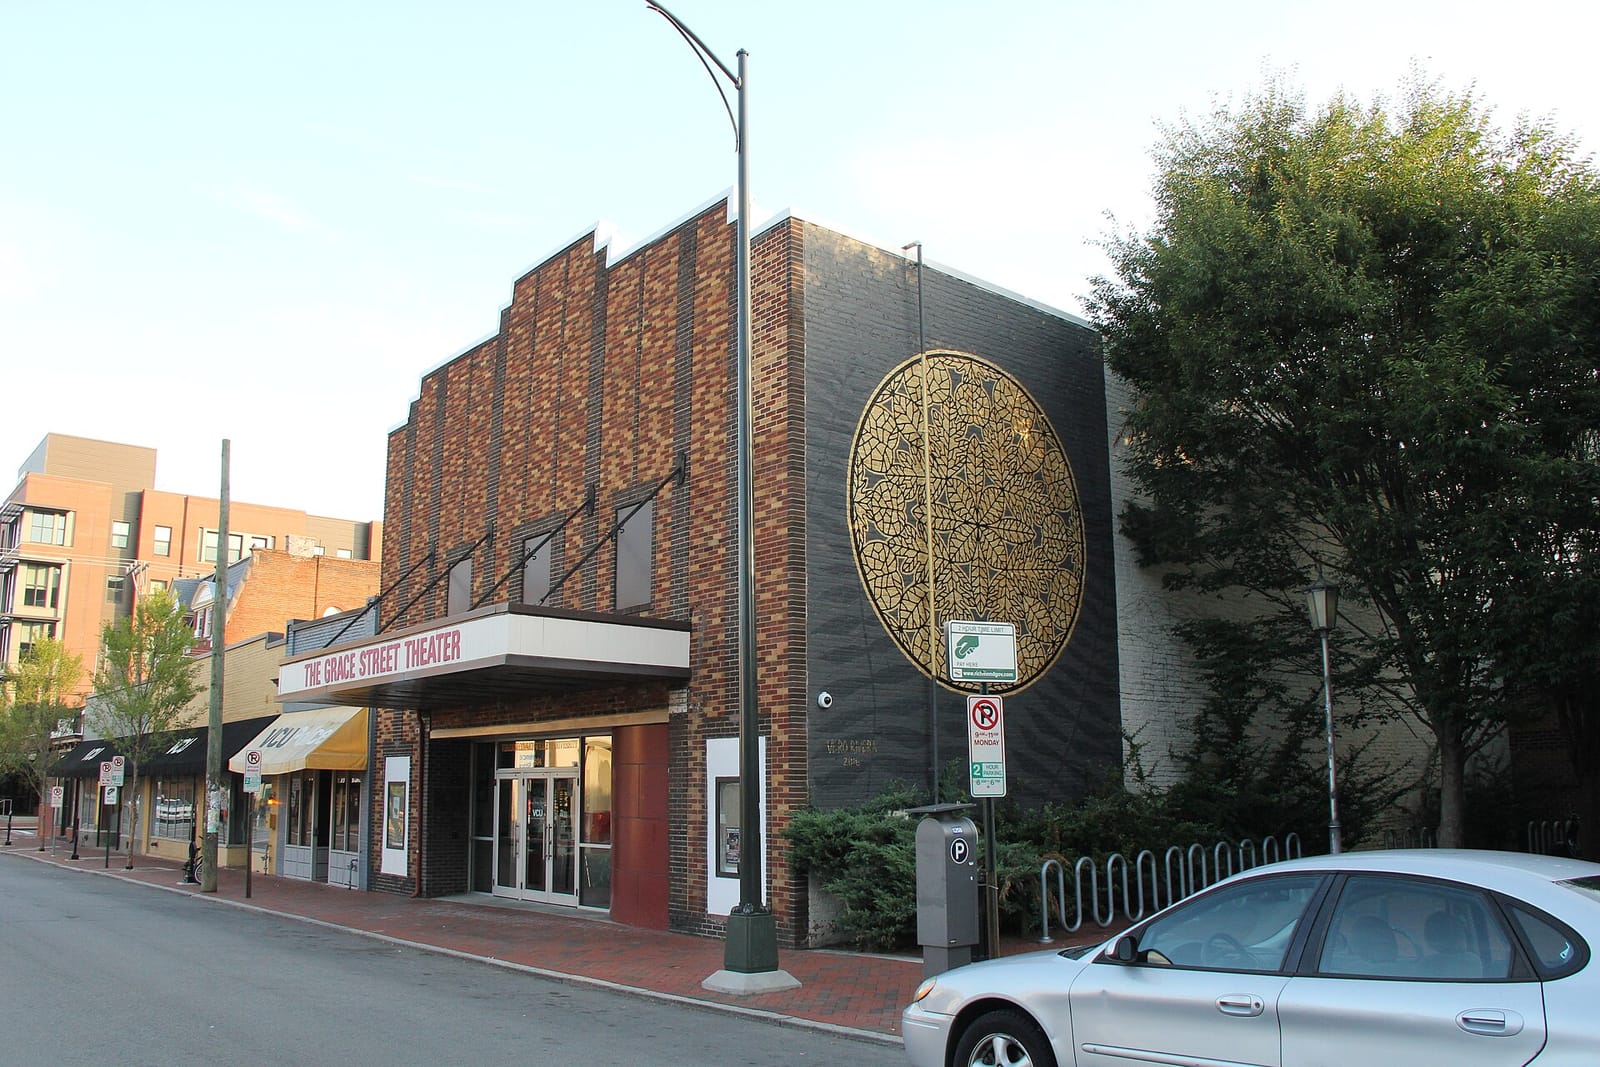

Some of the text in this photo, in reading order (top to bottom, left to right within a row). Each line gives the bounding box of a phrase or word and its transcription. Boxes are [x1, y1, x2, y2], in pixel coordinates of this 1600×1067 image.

[304, 629, 461, 687] THE GRACE STREET THEATER
[259, 727, 301, 748] VCU
[972, 763, 981, 776] 2
[532, 808, 543, 817] VCU
[955, 842, 965, 860] P
